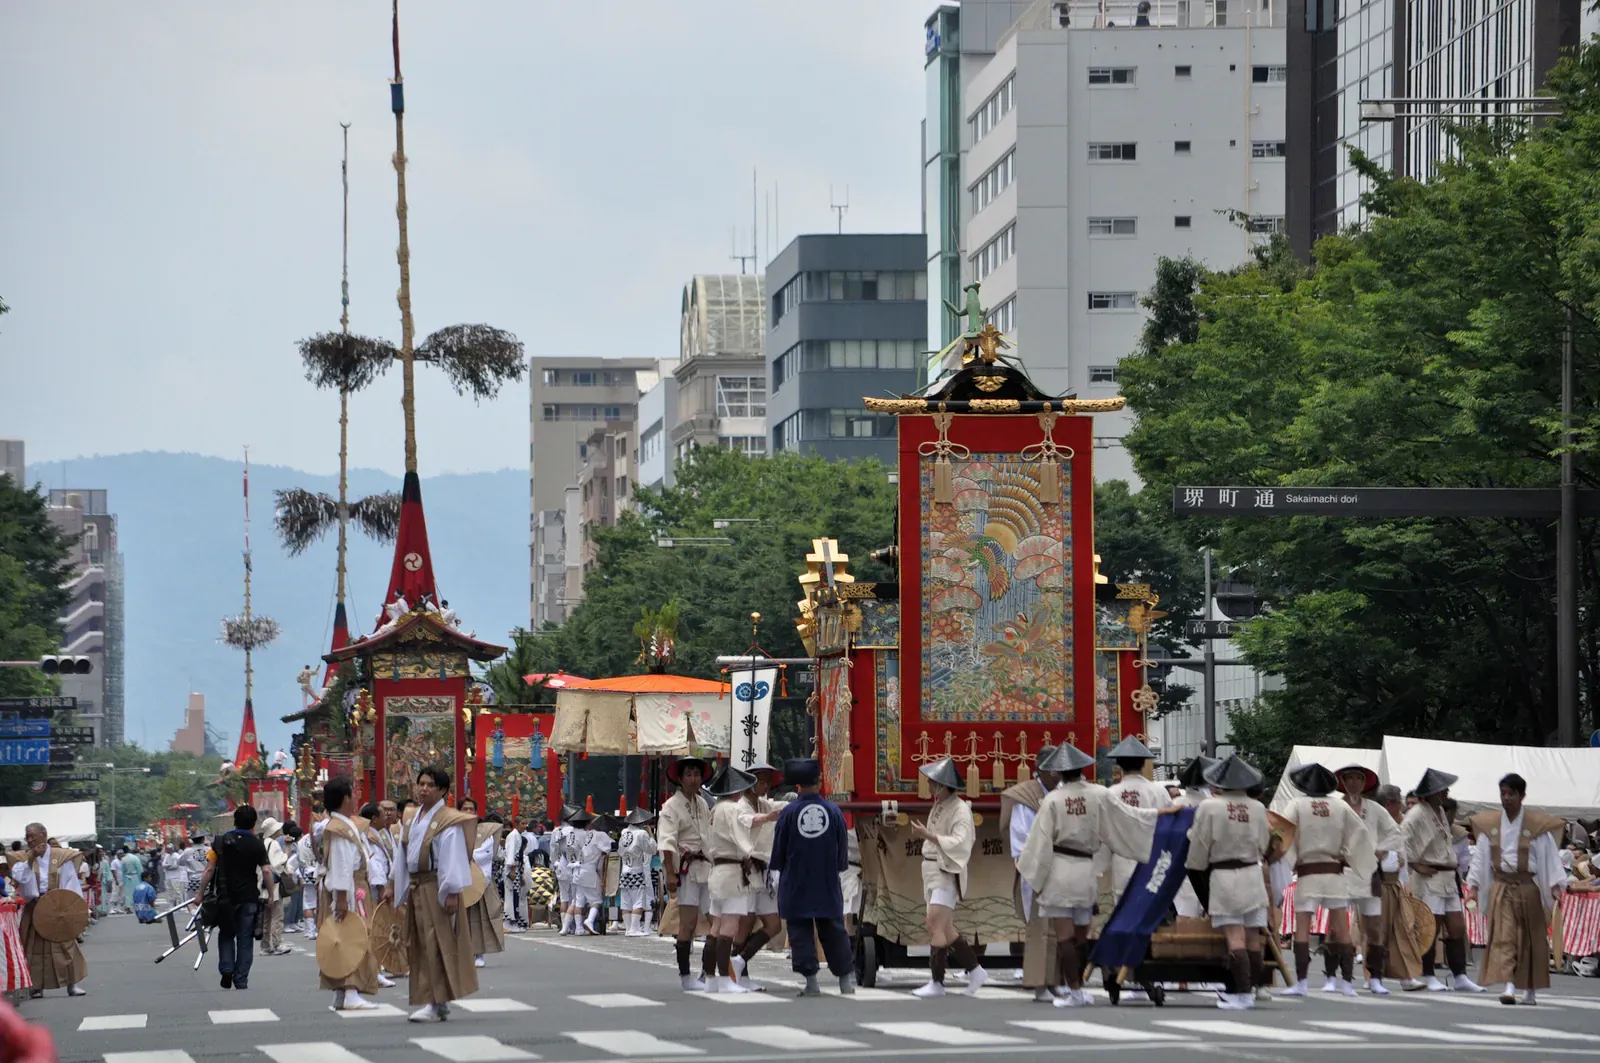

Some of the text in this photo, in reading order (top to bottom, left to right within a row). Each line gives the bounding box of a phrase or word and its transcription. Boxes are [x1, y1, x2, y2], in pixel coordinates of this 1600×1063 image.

[1183, 488, 1275, 508] 堺町通
[1285, 494, 1358, 504] Sakaimachi dori
